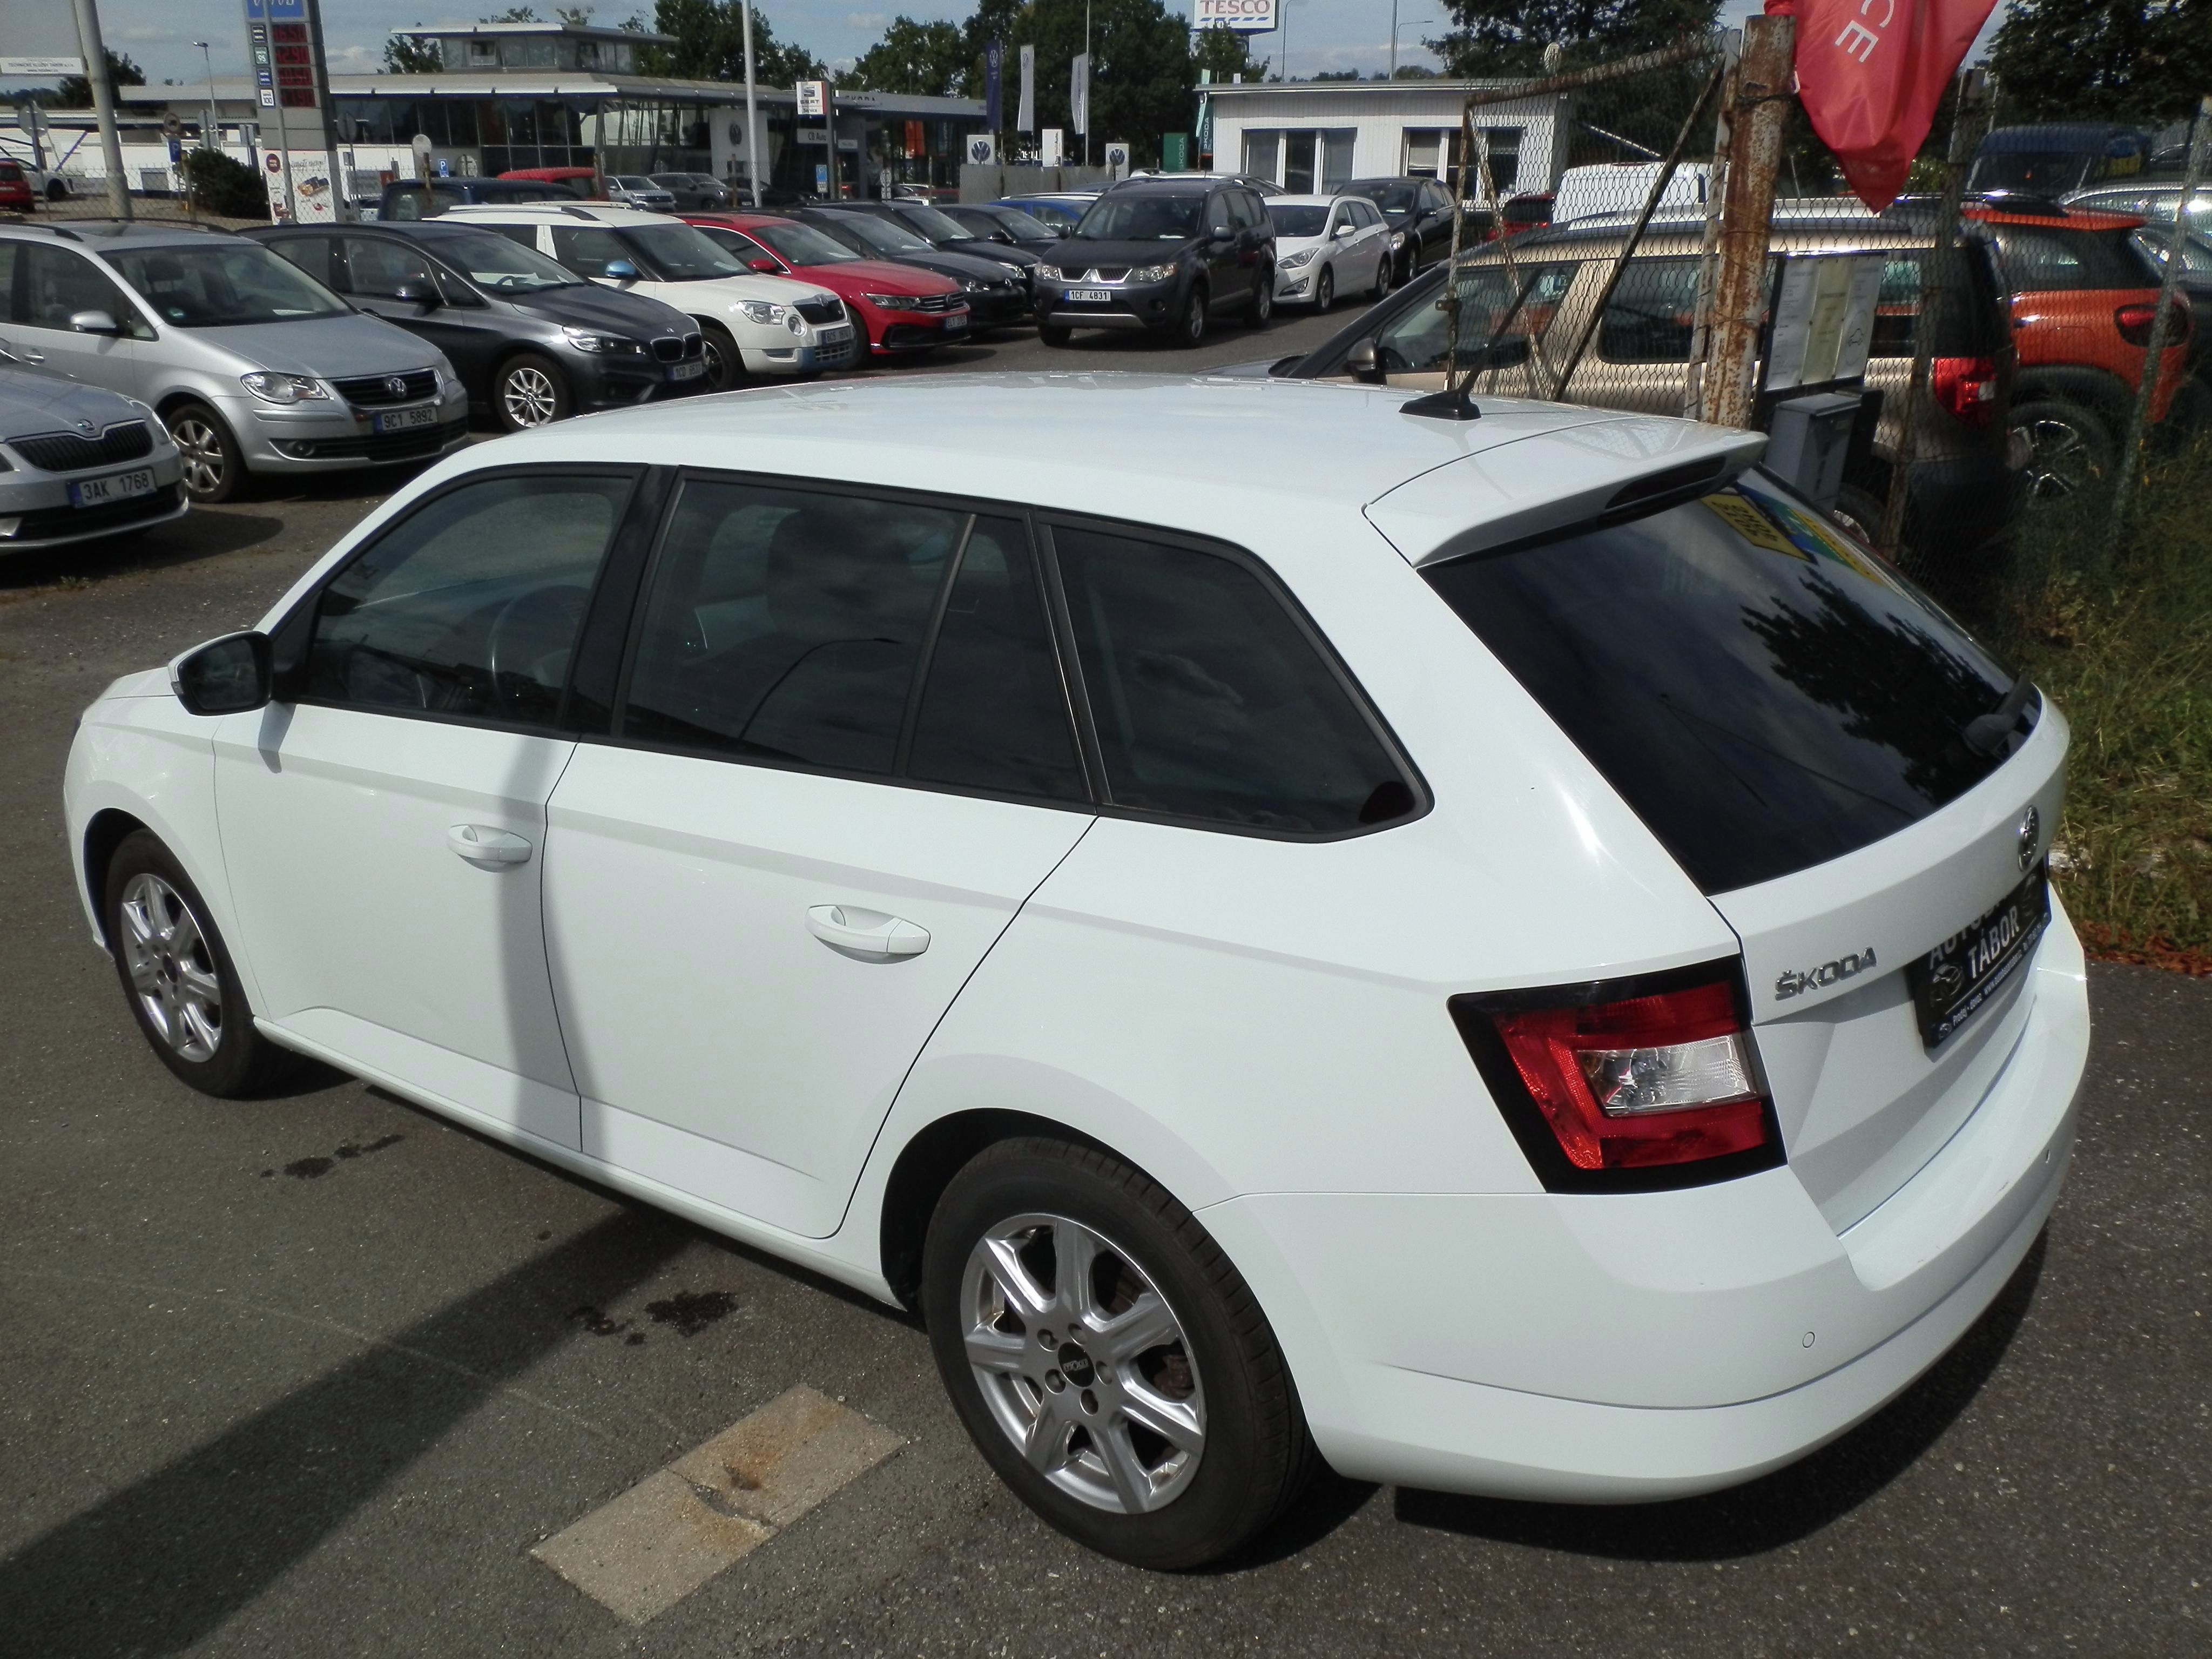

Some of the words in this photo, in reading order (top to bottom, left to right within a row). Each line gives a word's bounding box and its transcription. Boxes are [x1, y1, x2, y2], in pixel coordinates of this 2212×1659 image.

[1200, 0, 1270, 14] TESCO
[1071, 291, 1083, 299] 1CF
[1089, 292, 1107, 300] 4831
[384, 414, 402, 428] 9C1
[409, 409, 433, 424] 5892
[83, 480, 110, 500] 3AK
[118, 473, 150, 493] 1768
[1967, 905, 2020, 979] TÁBOR
[1775, 946, 1877, 1001] ŠKODA
